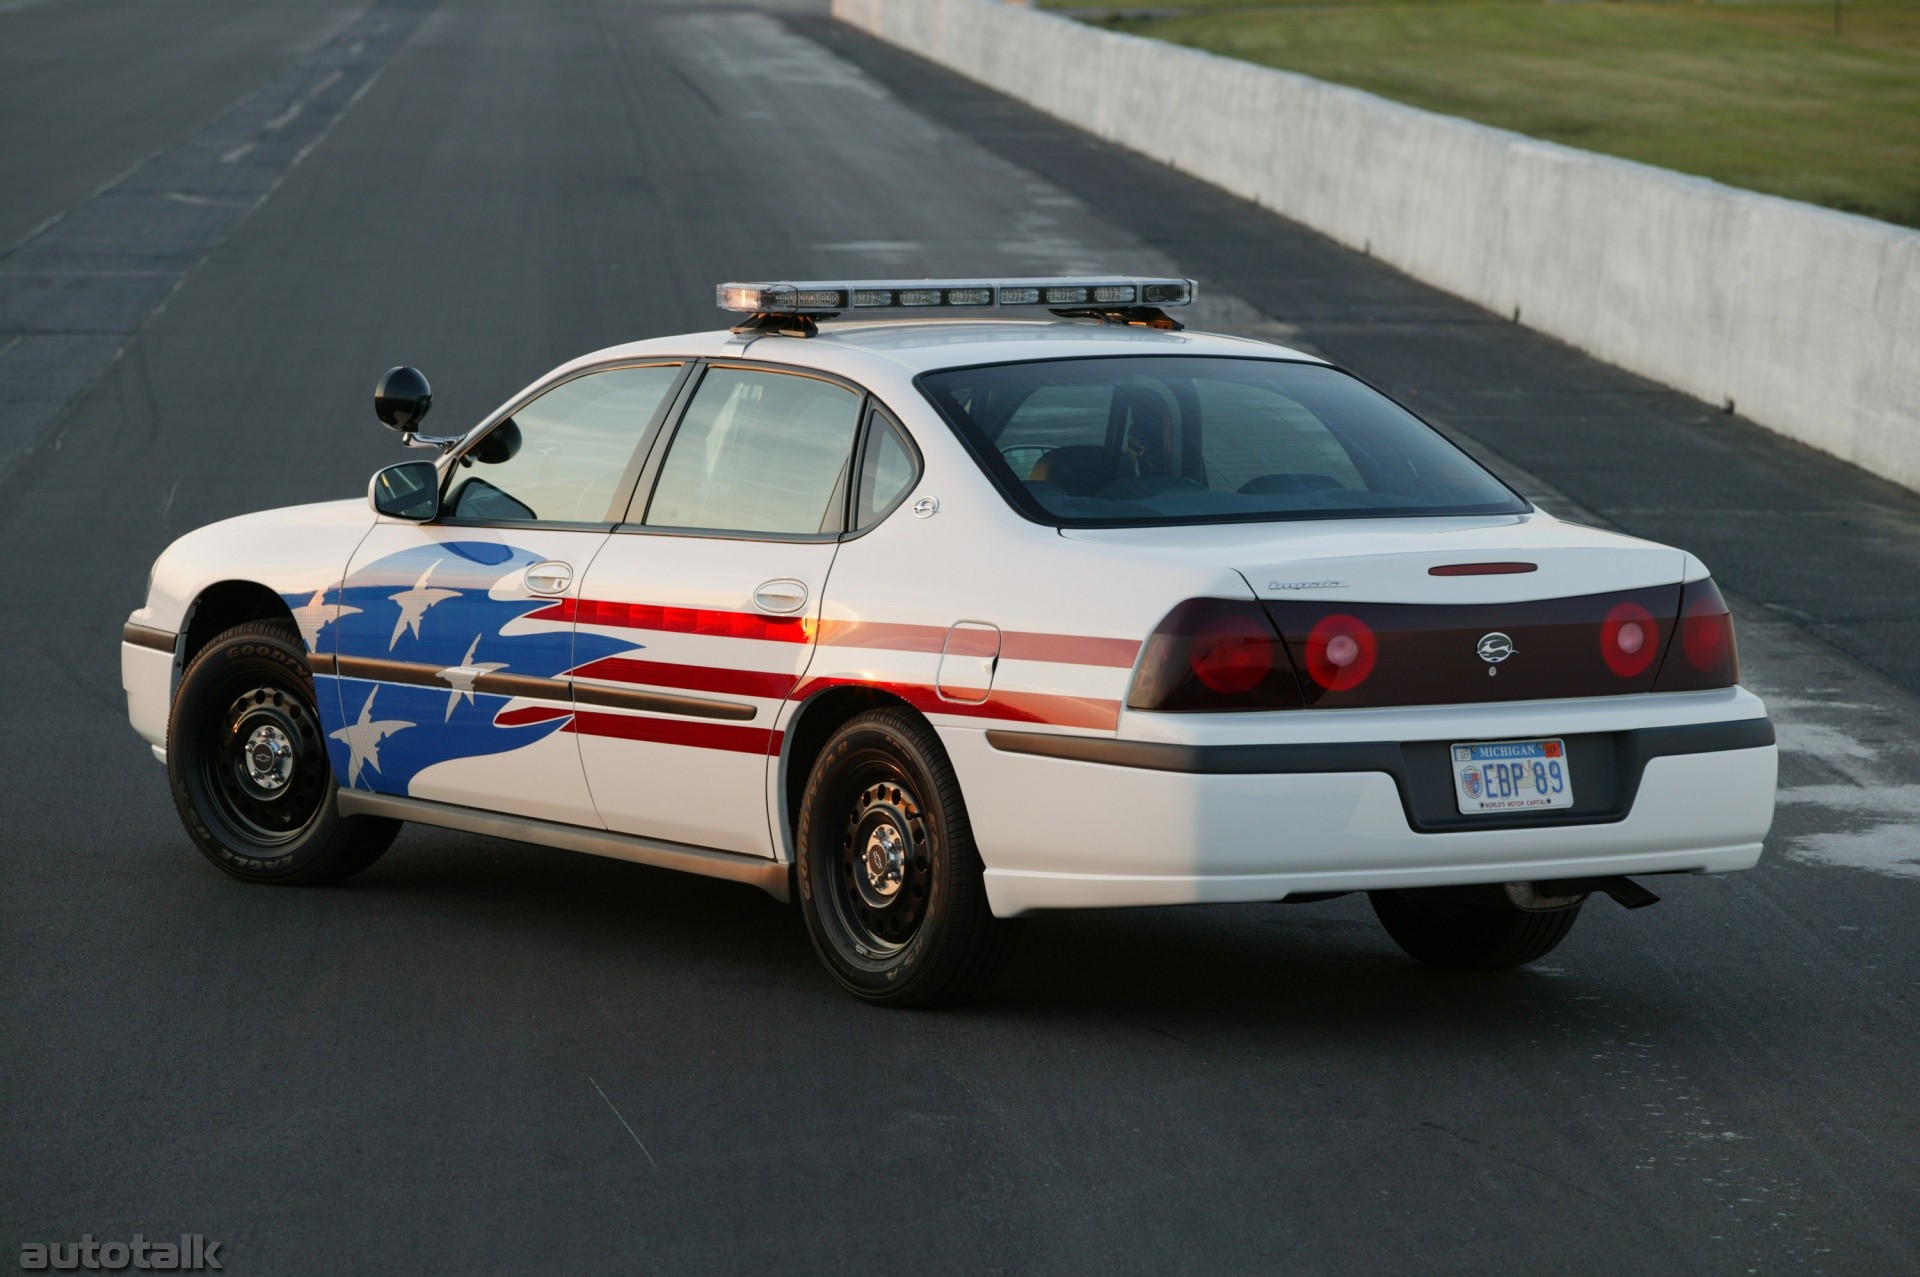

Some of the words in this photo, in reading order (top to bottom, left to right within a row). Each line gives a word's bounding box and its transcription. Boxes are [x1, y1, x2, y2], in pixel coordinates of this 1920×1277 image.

[1480, 745, 1535, 758] MICHIGAN
[1483, 763, 1523, 798] EBP
[1533, 760, 1564, 795] 89
[216, 848, 294, 870] EAGLE
